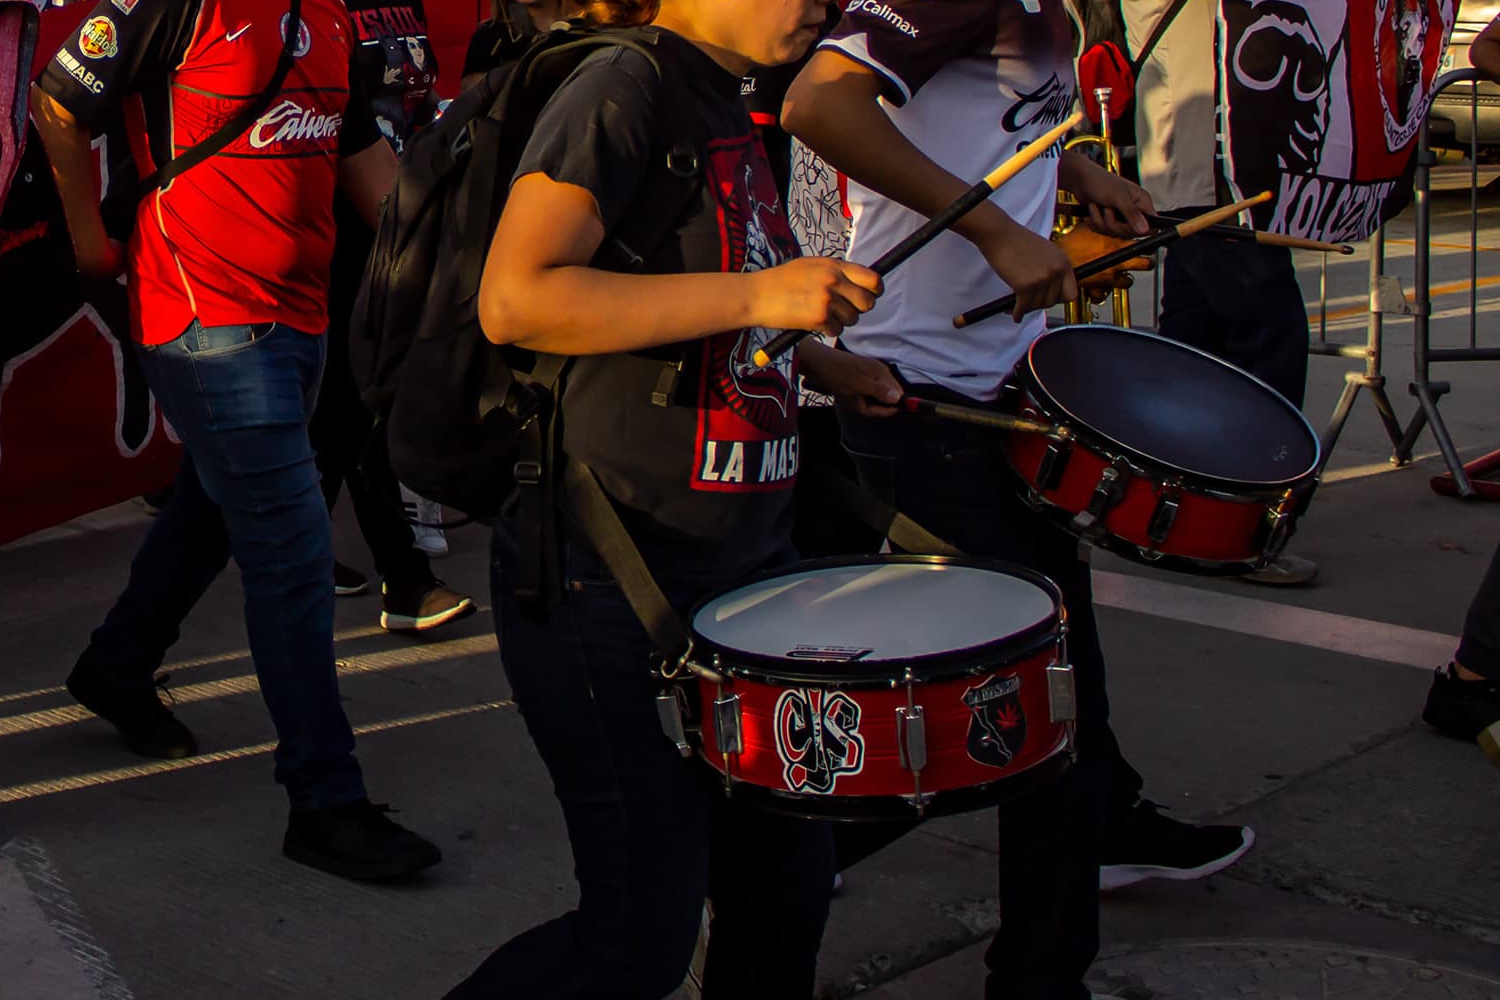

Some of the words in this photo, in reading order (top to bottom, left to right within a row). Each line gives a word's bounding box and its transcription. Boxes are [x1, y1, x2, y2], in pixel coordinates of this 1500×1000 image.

[862, 0, 920, 38] Calimax
[72, 64, 105, 94] ABC
[701, 440, 744, 482] LA
[758, 433, 799, 482] MAS
